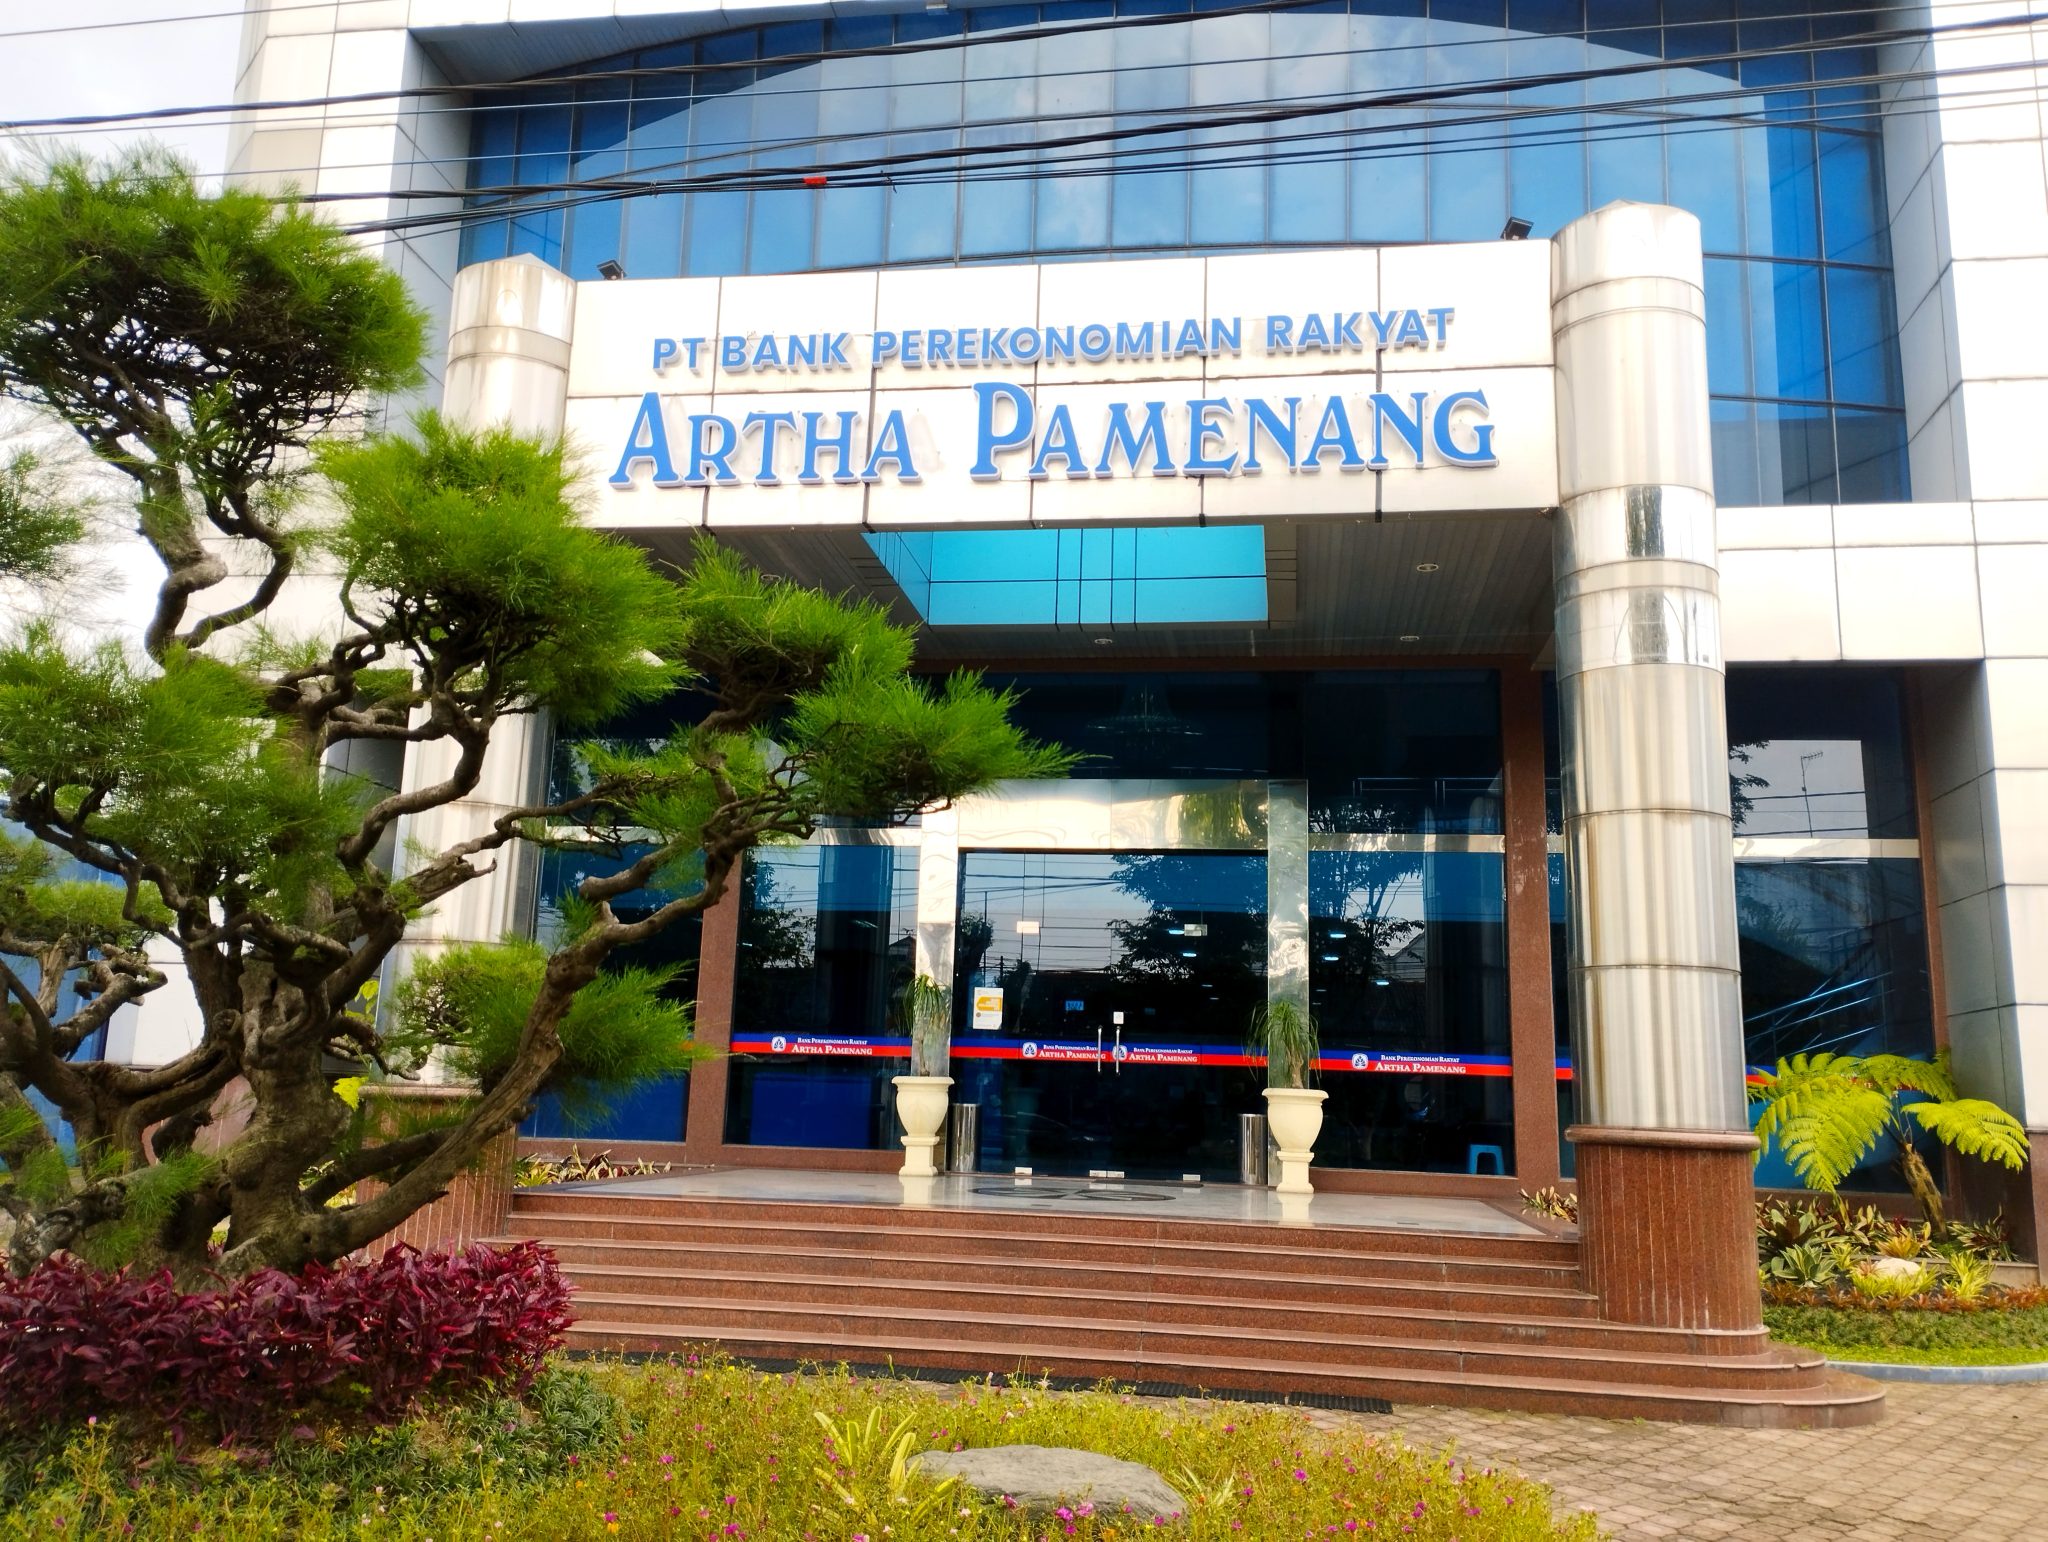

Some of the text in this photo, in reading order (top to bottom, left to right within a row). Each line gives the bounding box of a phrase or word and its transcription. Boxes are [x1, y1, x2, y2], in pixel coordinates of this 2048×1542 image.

[653, 307, 1455, 374] PT BANK PEREKONOMIAN RAKYAT
[608, 381, 1499, 488] ARTHA PAMENANG
[791, 1044, 873, 1055] ARTHA PAMENANG
[1038, 1050, 1066, 1058] ARTHA
[1129, 1052, 1198, 1063] ARTHA PAMENANG
[1375, 1062, 1467, 1074] ARTHA PAMENANG
